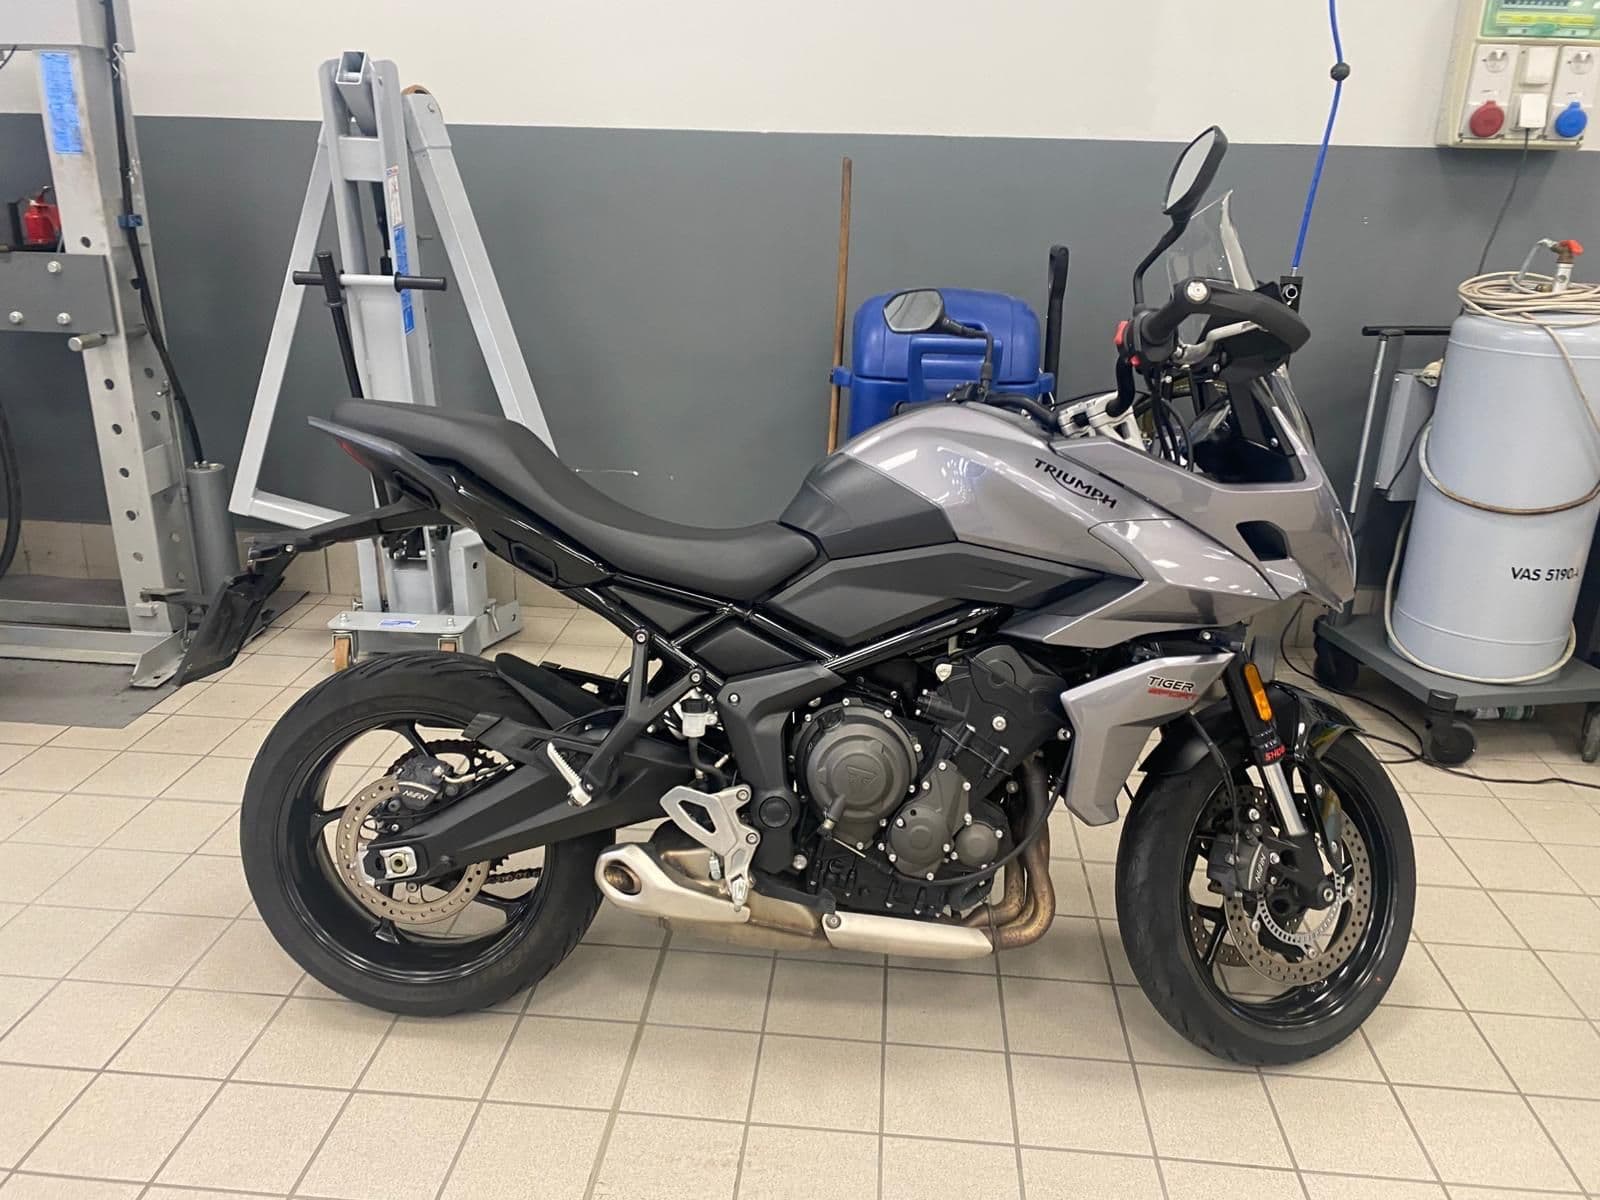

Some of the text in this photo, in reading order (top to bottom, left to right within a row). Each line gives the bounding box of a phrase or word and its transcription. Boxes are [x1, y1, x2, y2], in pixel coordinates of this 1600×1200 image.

[1035, 458, 1117, 509] TRIUMPH
[1511, 566, 1542, 582] VAS
[1149, 675, 1195, 692] TIGER
